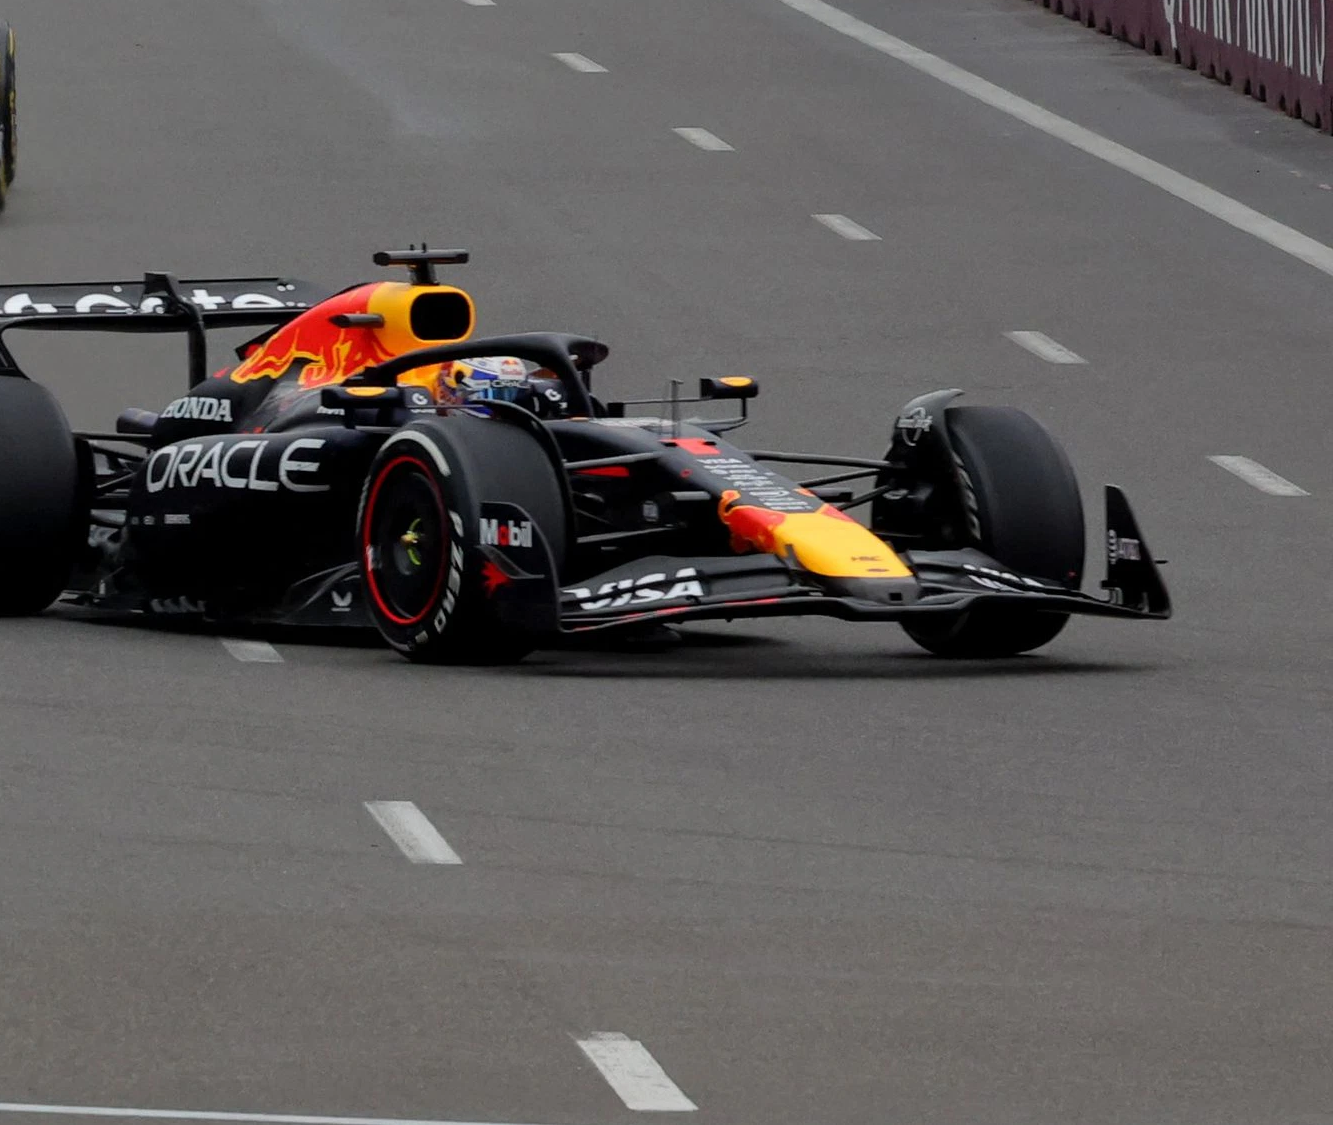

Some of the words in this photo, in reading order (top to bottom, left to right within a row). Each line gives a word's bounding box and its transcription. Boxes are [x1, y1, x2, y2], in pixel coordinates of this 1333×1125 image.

[161, 396, 233, 422] HONDA
[145, 438, 331, 494] ORACLE
[479, 517, 532, 548] Mobil
[561, 567, 705, 611] VISA
